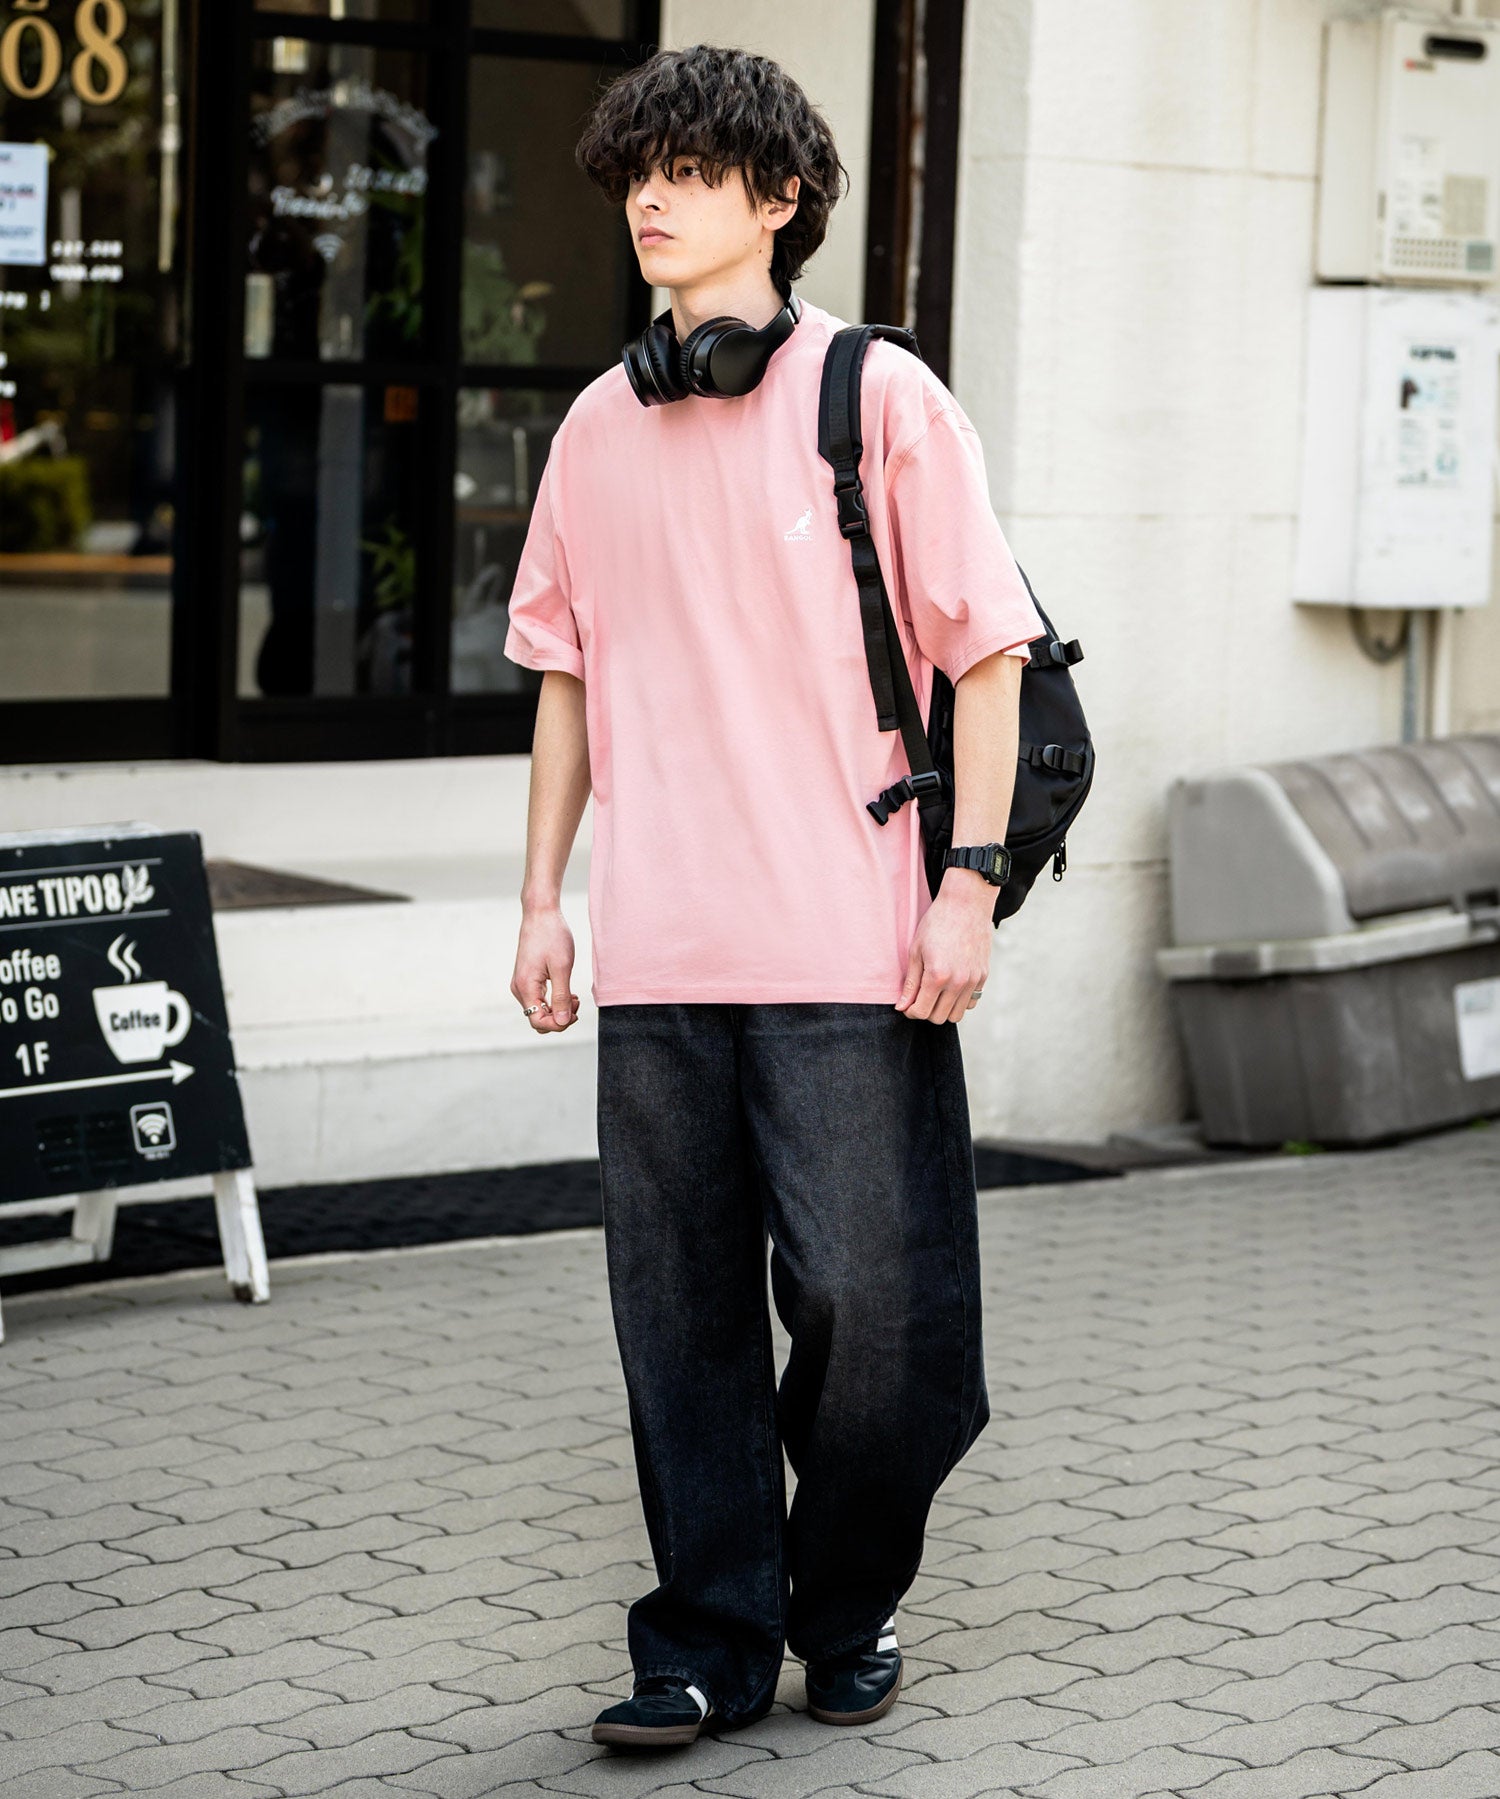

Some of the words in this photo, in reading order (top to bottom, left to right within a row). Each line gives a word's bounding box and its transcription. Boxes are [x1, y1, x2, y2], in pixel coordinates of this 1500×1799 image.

[0, 884, 38, 918] AFE
[0, 948, 61, 984] offee
[0, 991, 18, 1023] o
[24, 987, 60, 1021] Go
[109, 1009, 161, 1032] Coffee
[15, 1041, 50, 1077] 1F
